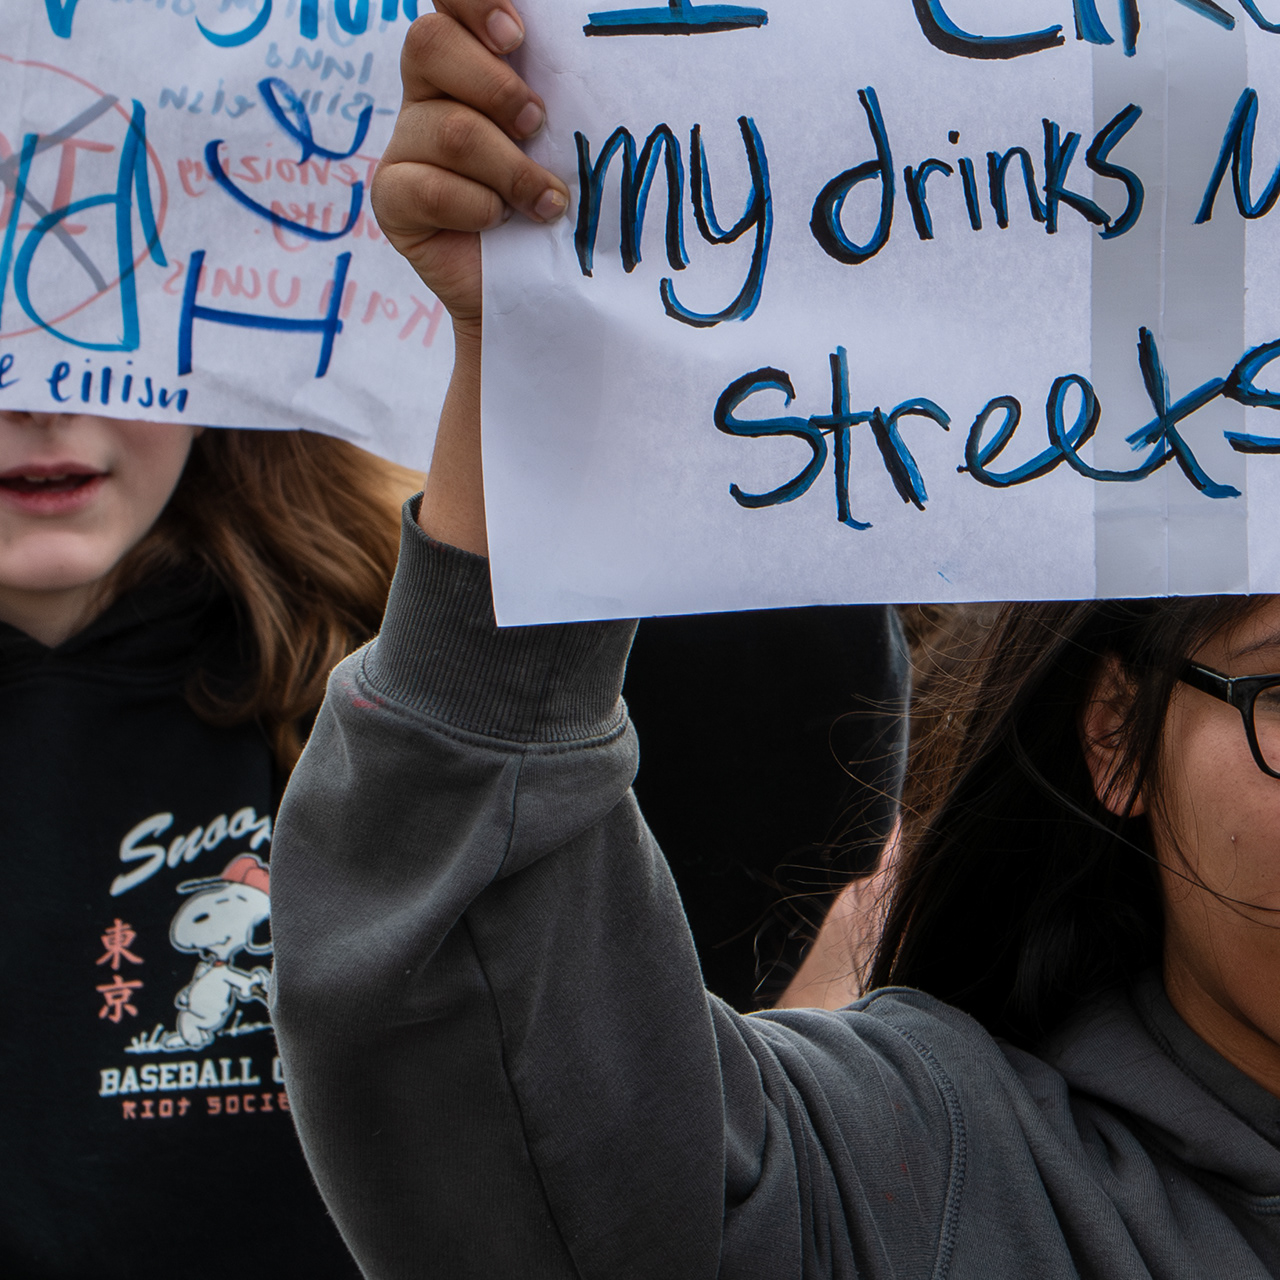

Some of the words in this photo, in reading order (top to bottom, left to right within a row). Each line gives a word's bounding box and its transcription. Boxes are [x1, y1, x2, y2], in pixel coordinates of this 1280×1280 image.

[573, 116, 774, 324] my
[809, 85, 1144, 265] drinks
[94, 917, 146, 1024] 東京
[98, 1057, 262, 1098] BASEBALL
[206, 1091, 291, 1115] SOCIE
